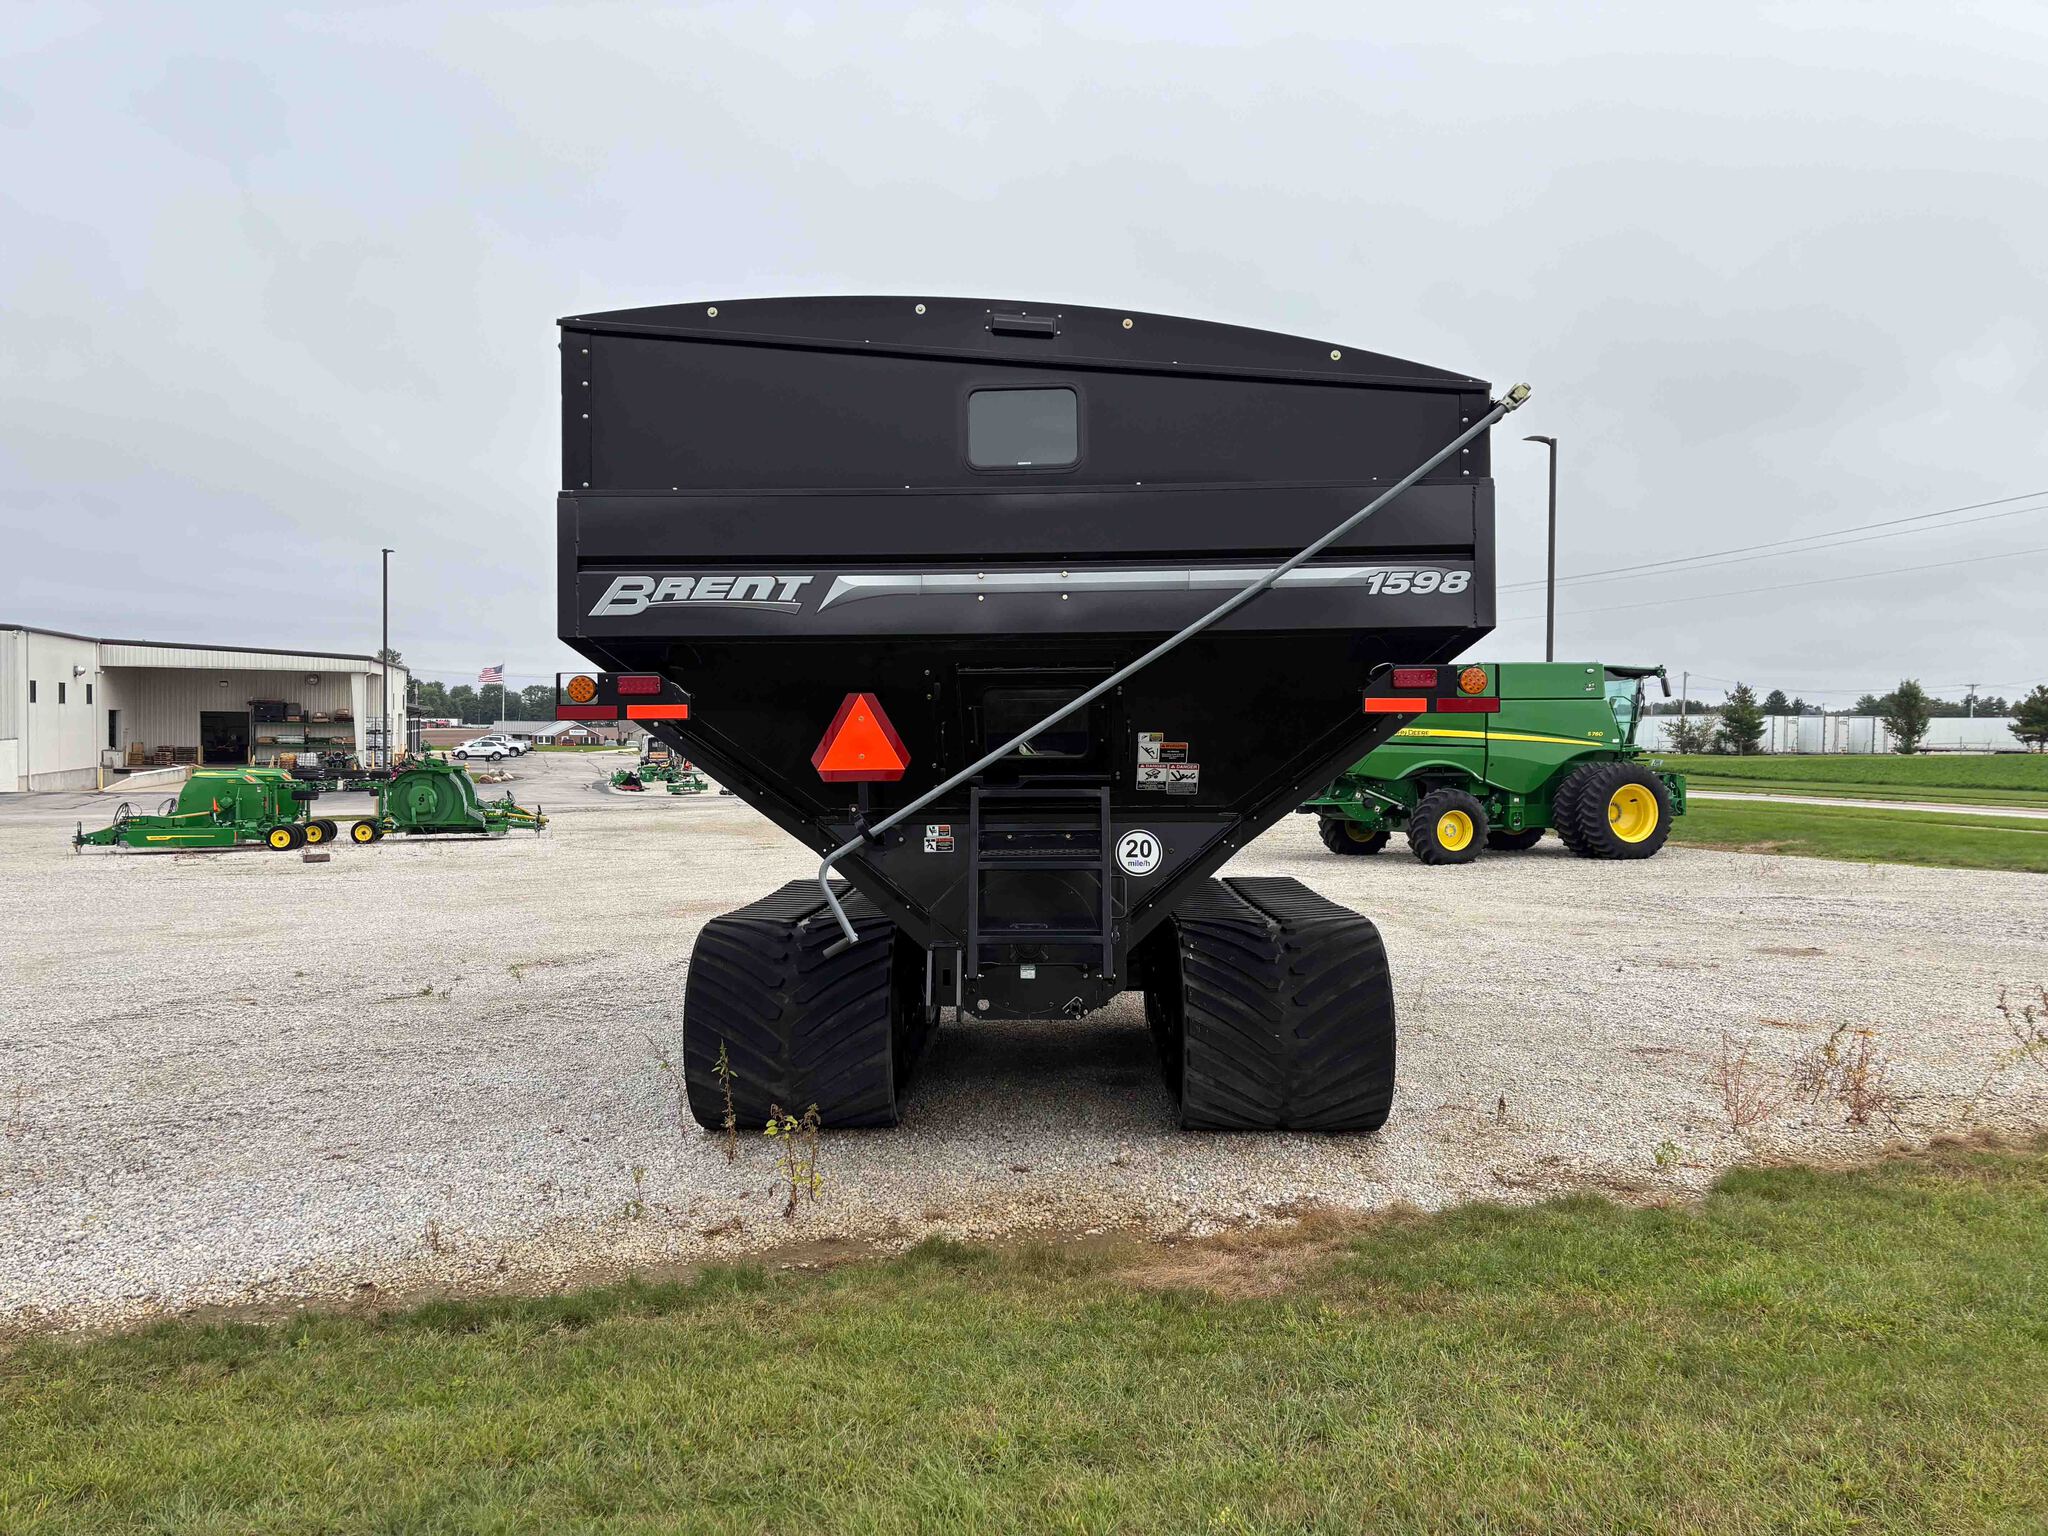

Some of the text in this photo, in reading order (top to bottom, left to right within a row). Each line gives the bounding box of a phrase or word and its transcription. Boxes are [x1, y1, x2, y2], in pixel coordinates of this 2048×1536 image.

[1367, 570, 1472, 595] 1598
[588, 575, 814, 616] BRENT
[1125, 839, 1152, 858] 20
